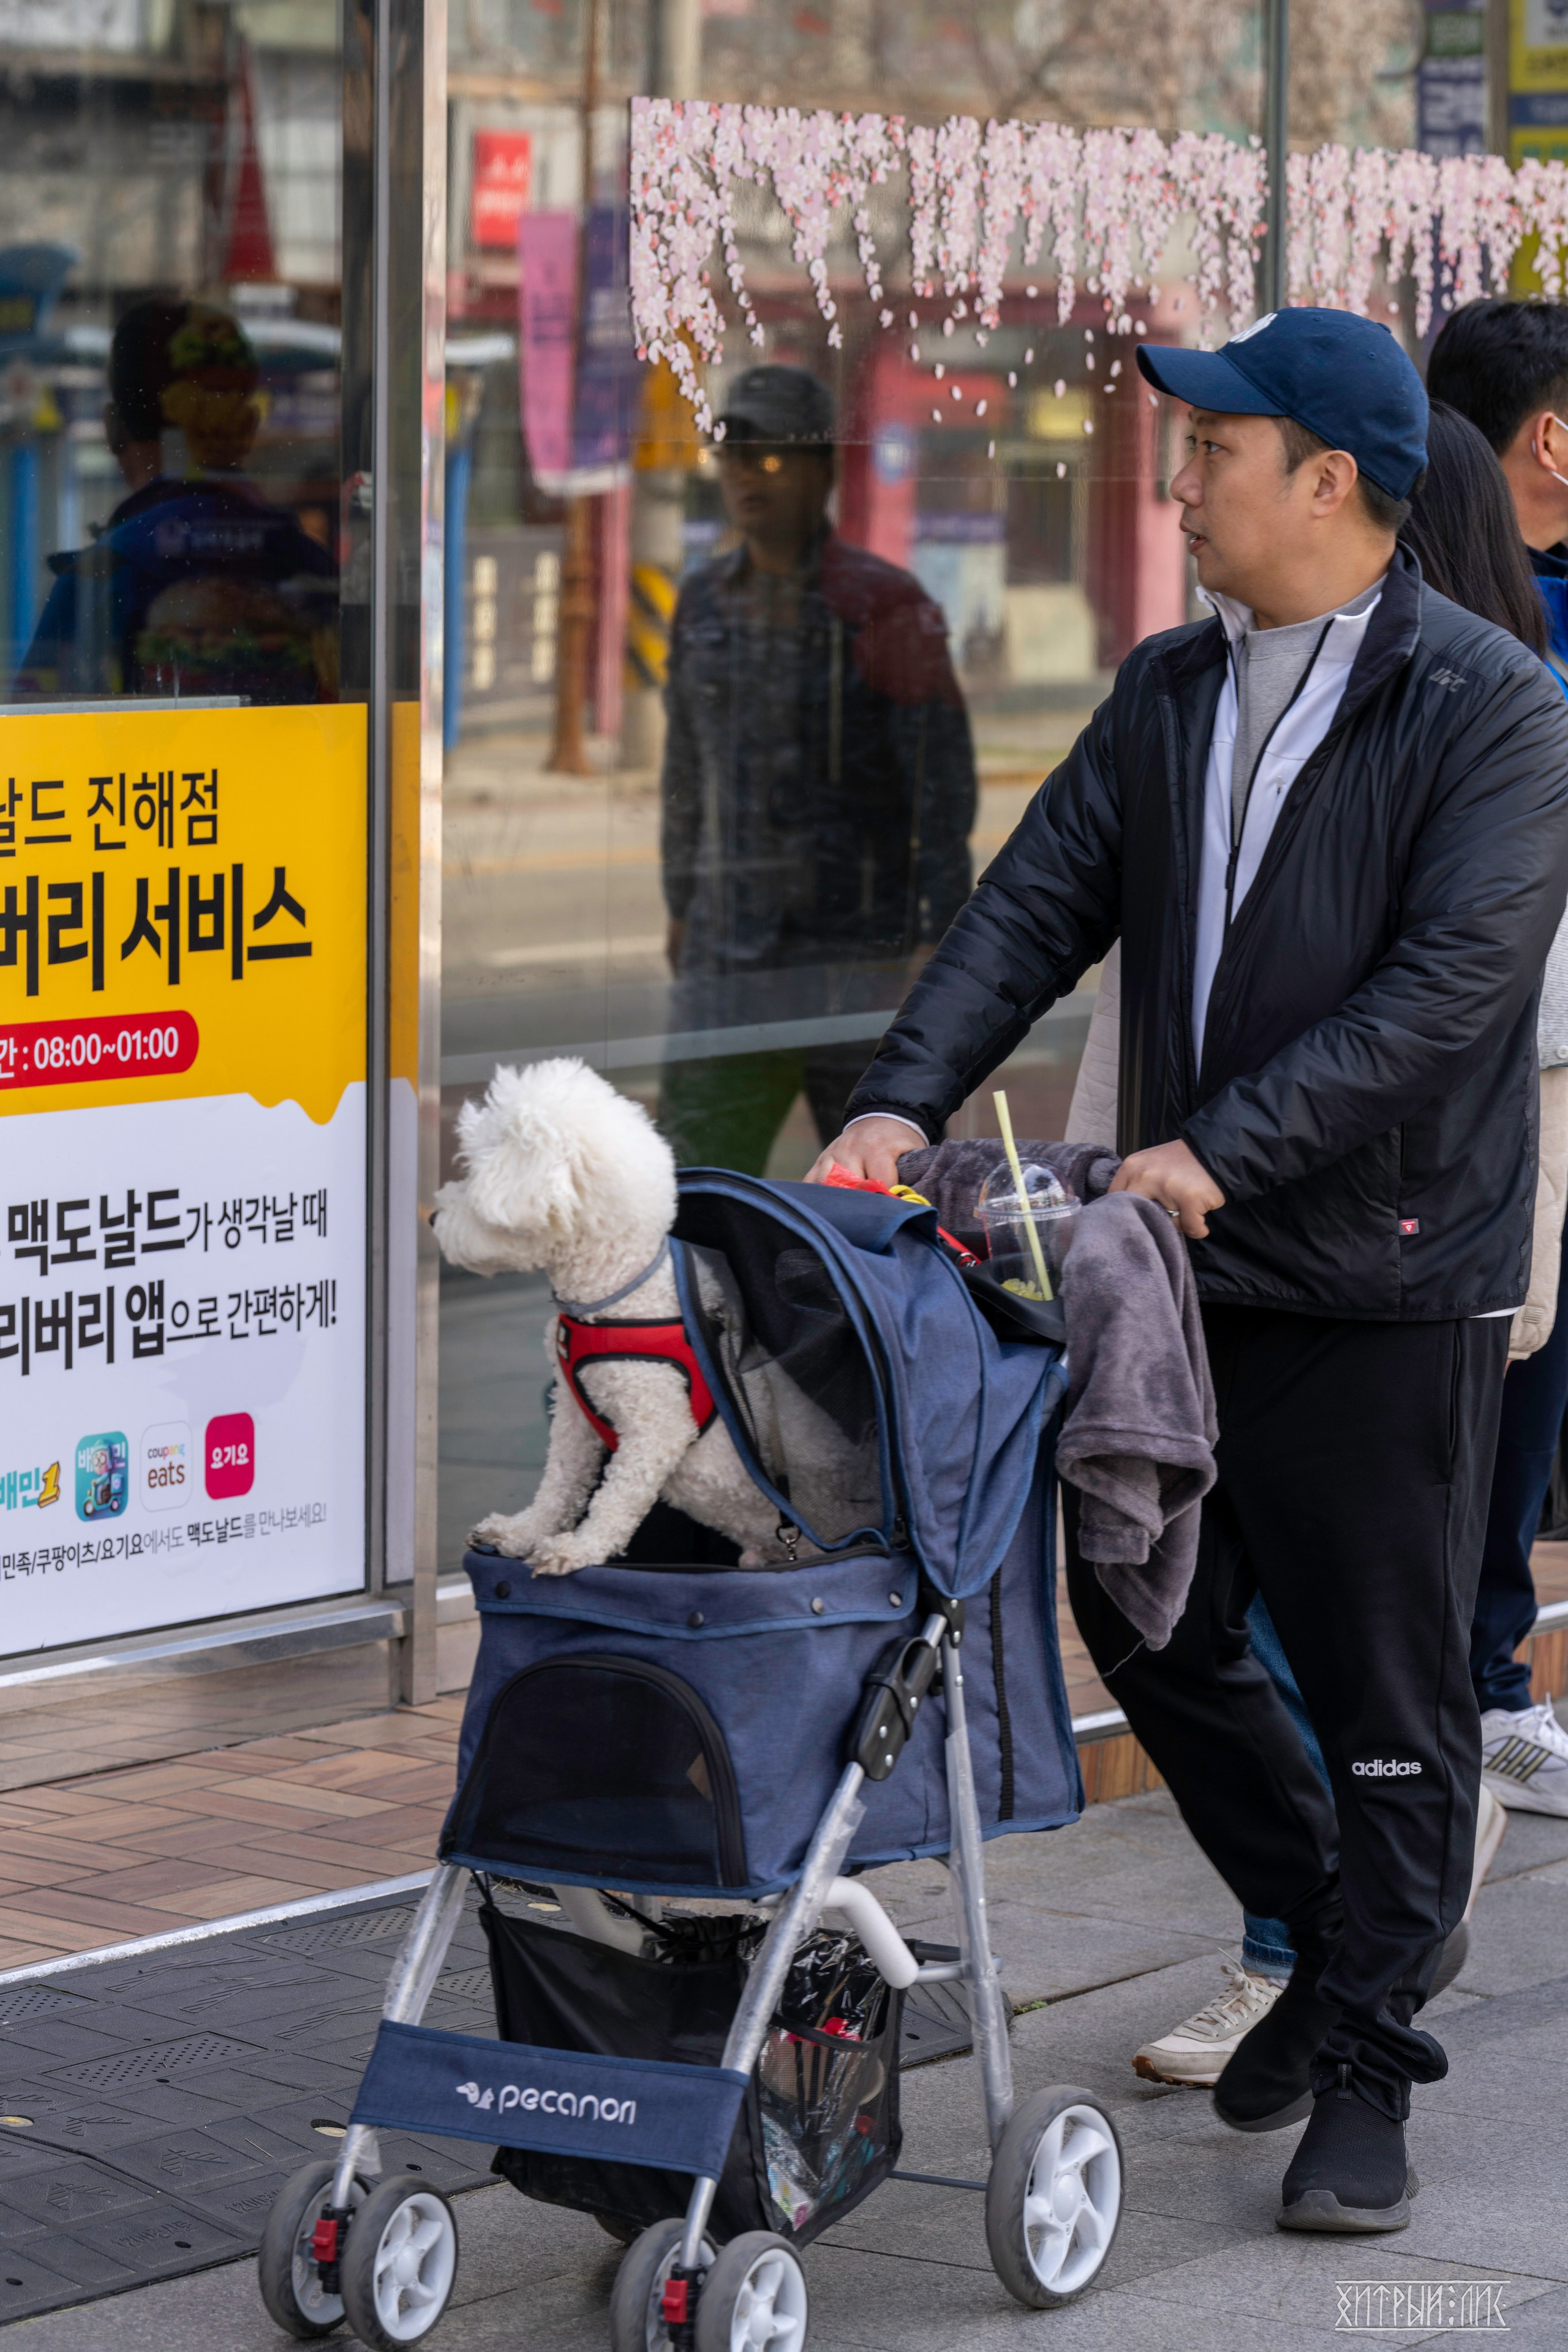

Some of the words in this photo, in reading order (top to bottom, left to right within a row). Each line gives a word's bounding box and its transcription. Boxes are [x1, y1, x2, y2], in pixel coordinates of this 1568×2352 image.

[87, 769, 218, 851] 진해점
[0, 871, 105, 997] 버리
[121, 863, 312, 986] 서비스
[8, 1188, 213, 1276] 맥도날드가
[217, 1192, 298, 1249] 생각날
[303, 1188, 326, 1237] 때
[126, 1279, 221, 1359] 앱으로
[227, 1278, 336, 1340] 간편하게!
[148, 1444, 185, 1460] coupang
[148, 1461, 185, 1489] eats
[211, 1442, 249, 1469] 요기요
[0, 1526, 185, 1581] 민족/쿠팡이츠/요기요에서도
[187, 1513, 257, 1547] 맥도날드를
[259, 1502, 326, 1536] 만나보세요!
[1352, 1759, 1422, 1776] adidas
